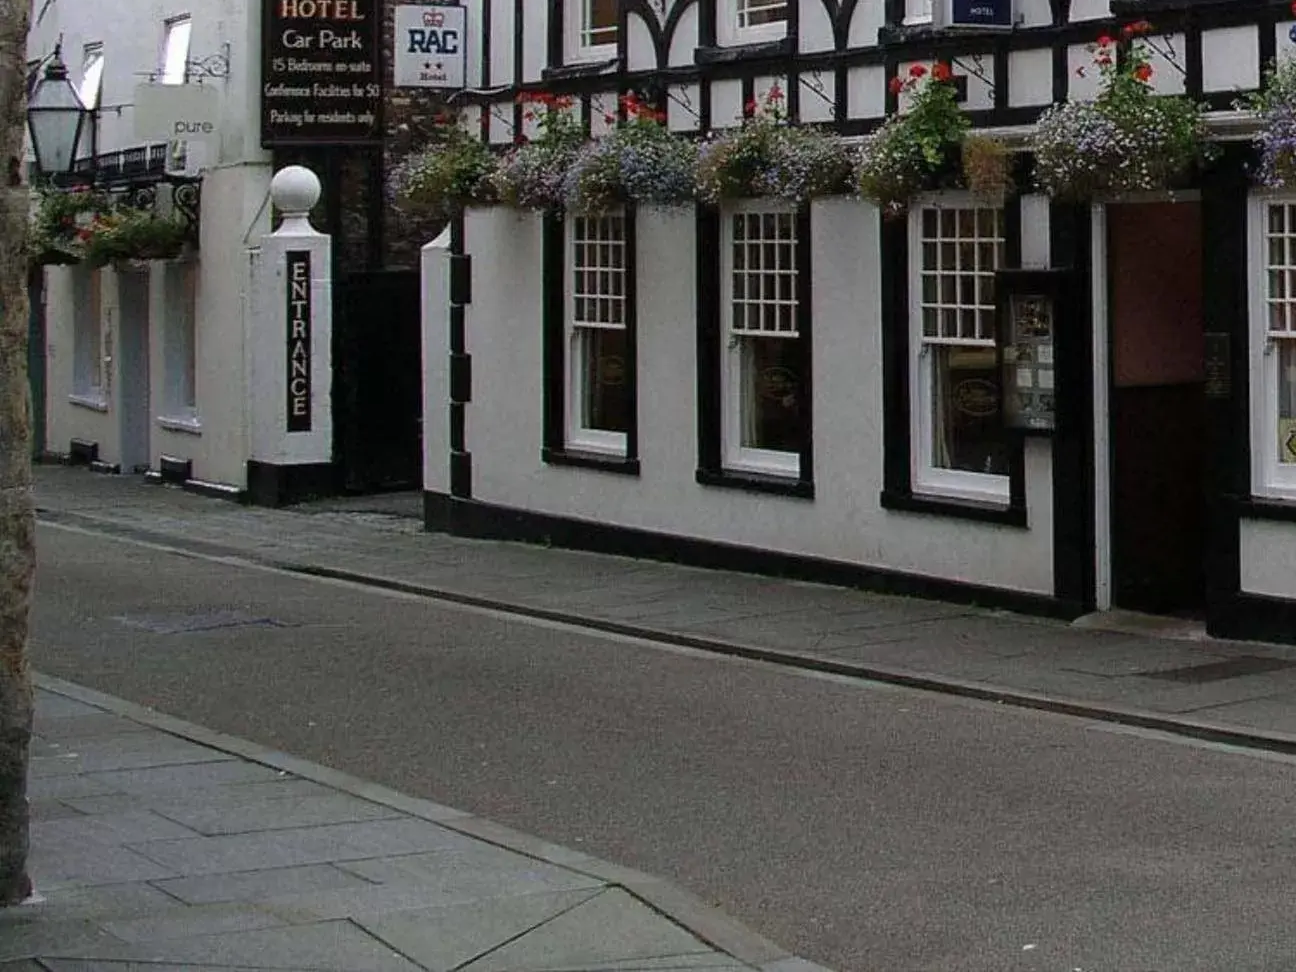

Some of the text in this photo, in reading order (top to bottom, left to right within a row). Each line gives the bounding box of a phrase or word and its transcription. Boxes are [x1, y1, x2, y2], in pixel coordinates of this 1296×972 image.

[282, 29, 362, 48] Car Park
[407, 29, 458, 54] RAC
[174, 121, 214, 135] pure
[291, 263, 307, 416] ENTRANCE
